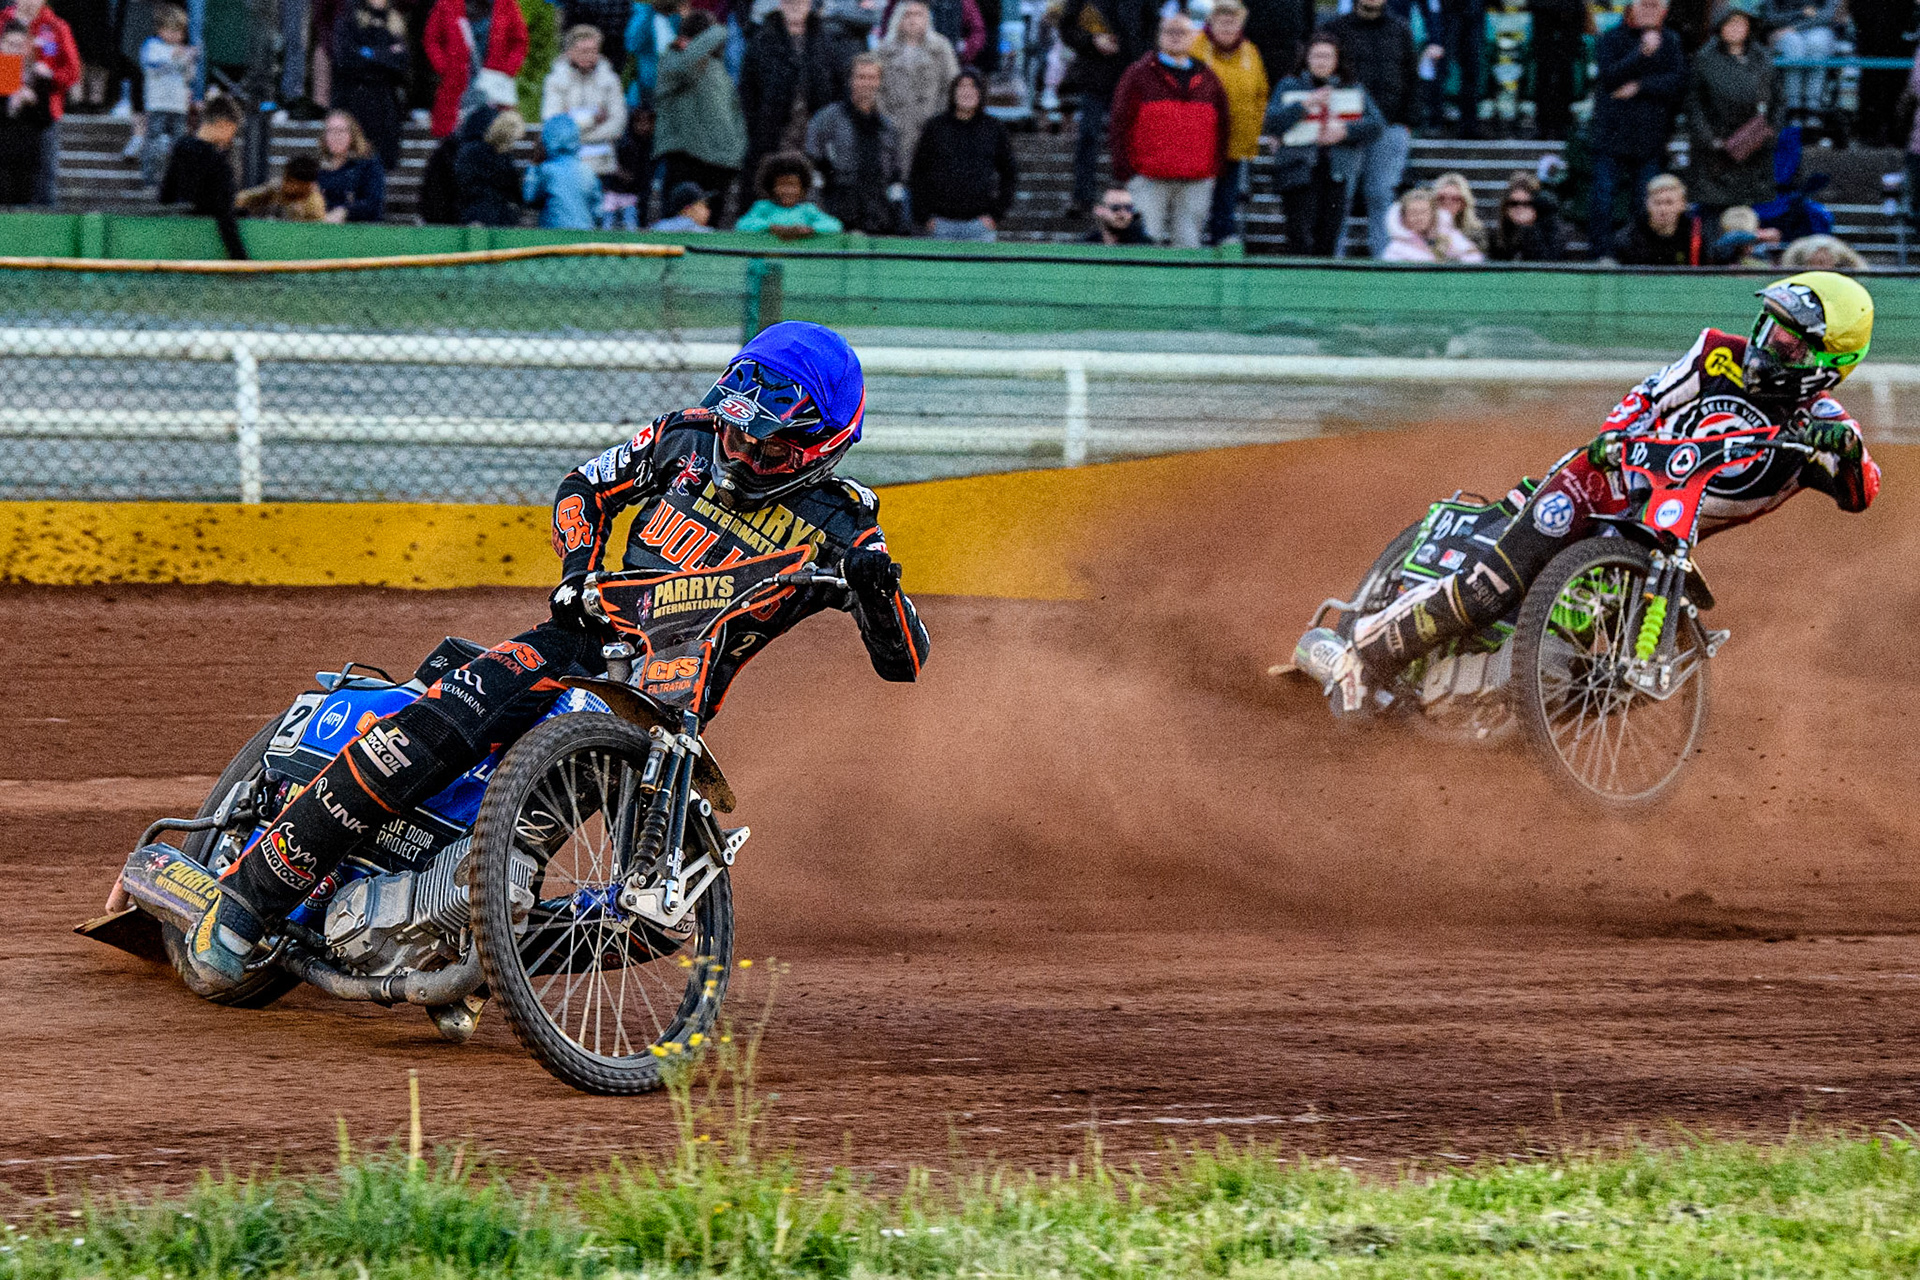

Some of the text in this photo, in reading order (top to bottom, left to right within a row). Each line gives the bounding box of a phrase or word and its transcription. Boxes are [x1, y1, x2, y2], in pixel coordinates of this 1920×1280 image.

[721, 399, 753, 418] STS
[1700, 400, 1764, 430] BELLE VUE
[691, 496, 783, 556] INTERNATI
[653, 575, 735, 608] PARRYS
[729, 633, 757, 657] 2
[646, 656, 701, 682] CFS
[646, 679, 692, 694] FILTRATION
[277, 705, 313, 738] 2
[322, 711, 344, 728] ATPI
[364, 731, 403, 774] ROCK OIL
[321, 791, 369, 834] LINK
[376, 830, 423, 863] PROJECT
[405, 824, 434, 850] DOOR
[155, 874, 209, 911] INTERNATIONAL
[161, 860, 222, 900] PARRYS
